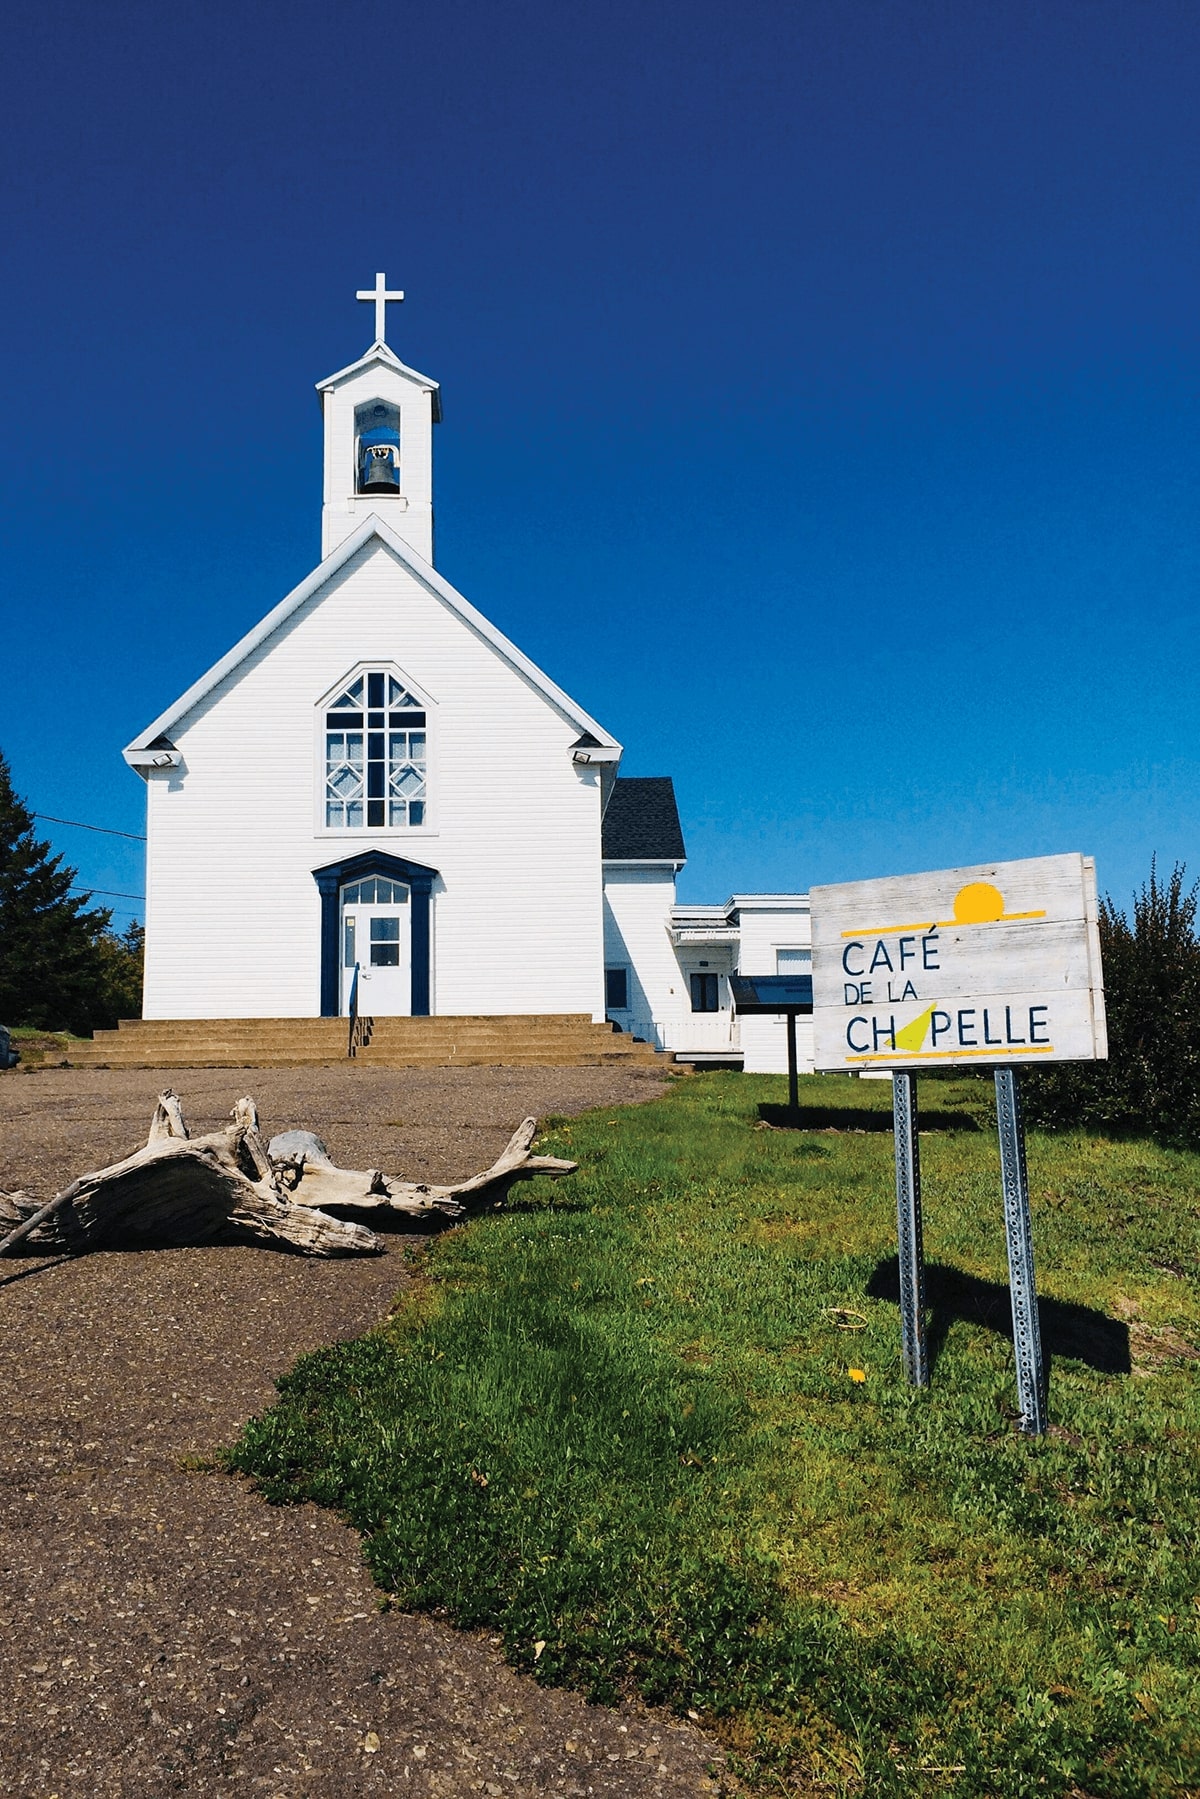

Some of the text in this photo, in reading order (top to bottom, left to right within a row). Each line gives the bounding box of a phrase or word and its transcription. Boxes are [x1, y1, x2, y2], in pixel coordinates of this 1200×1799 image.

[842, 924, 940, 976] CAFÉ
[844, 979, 918, 1006] DE LA
